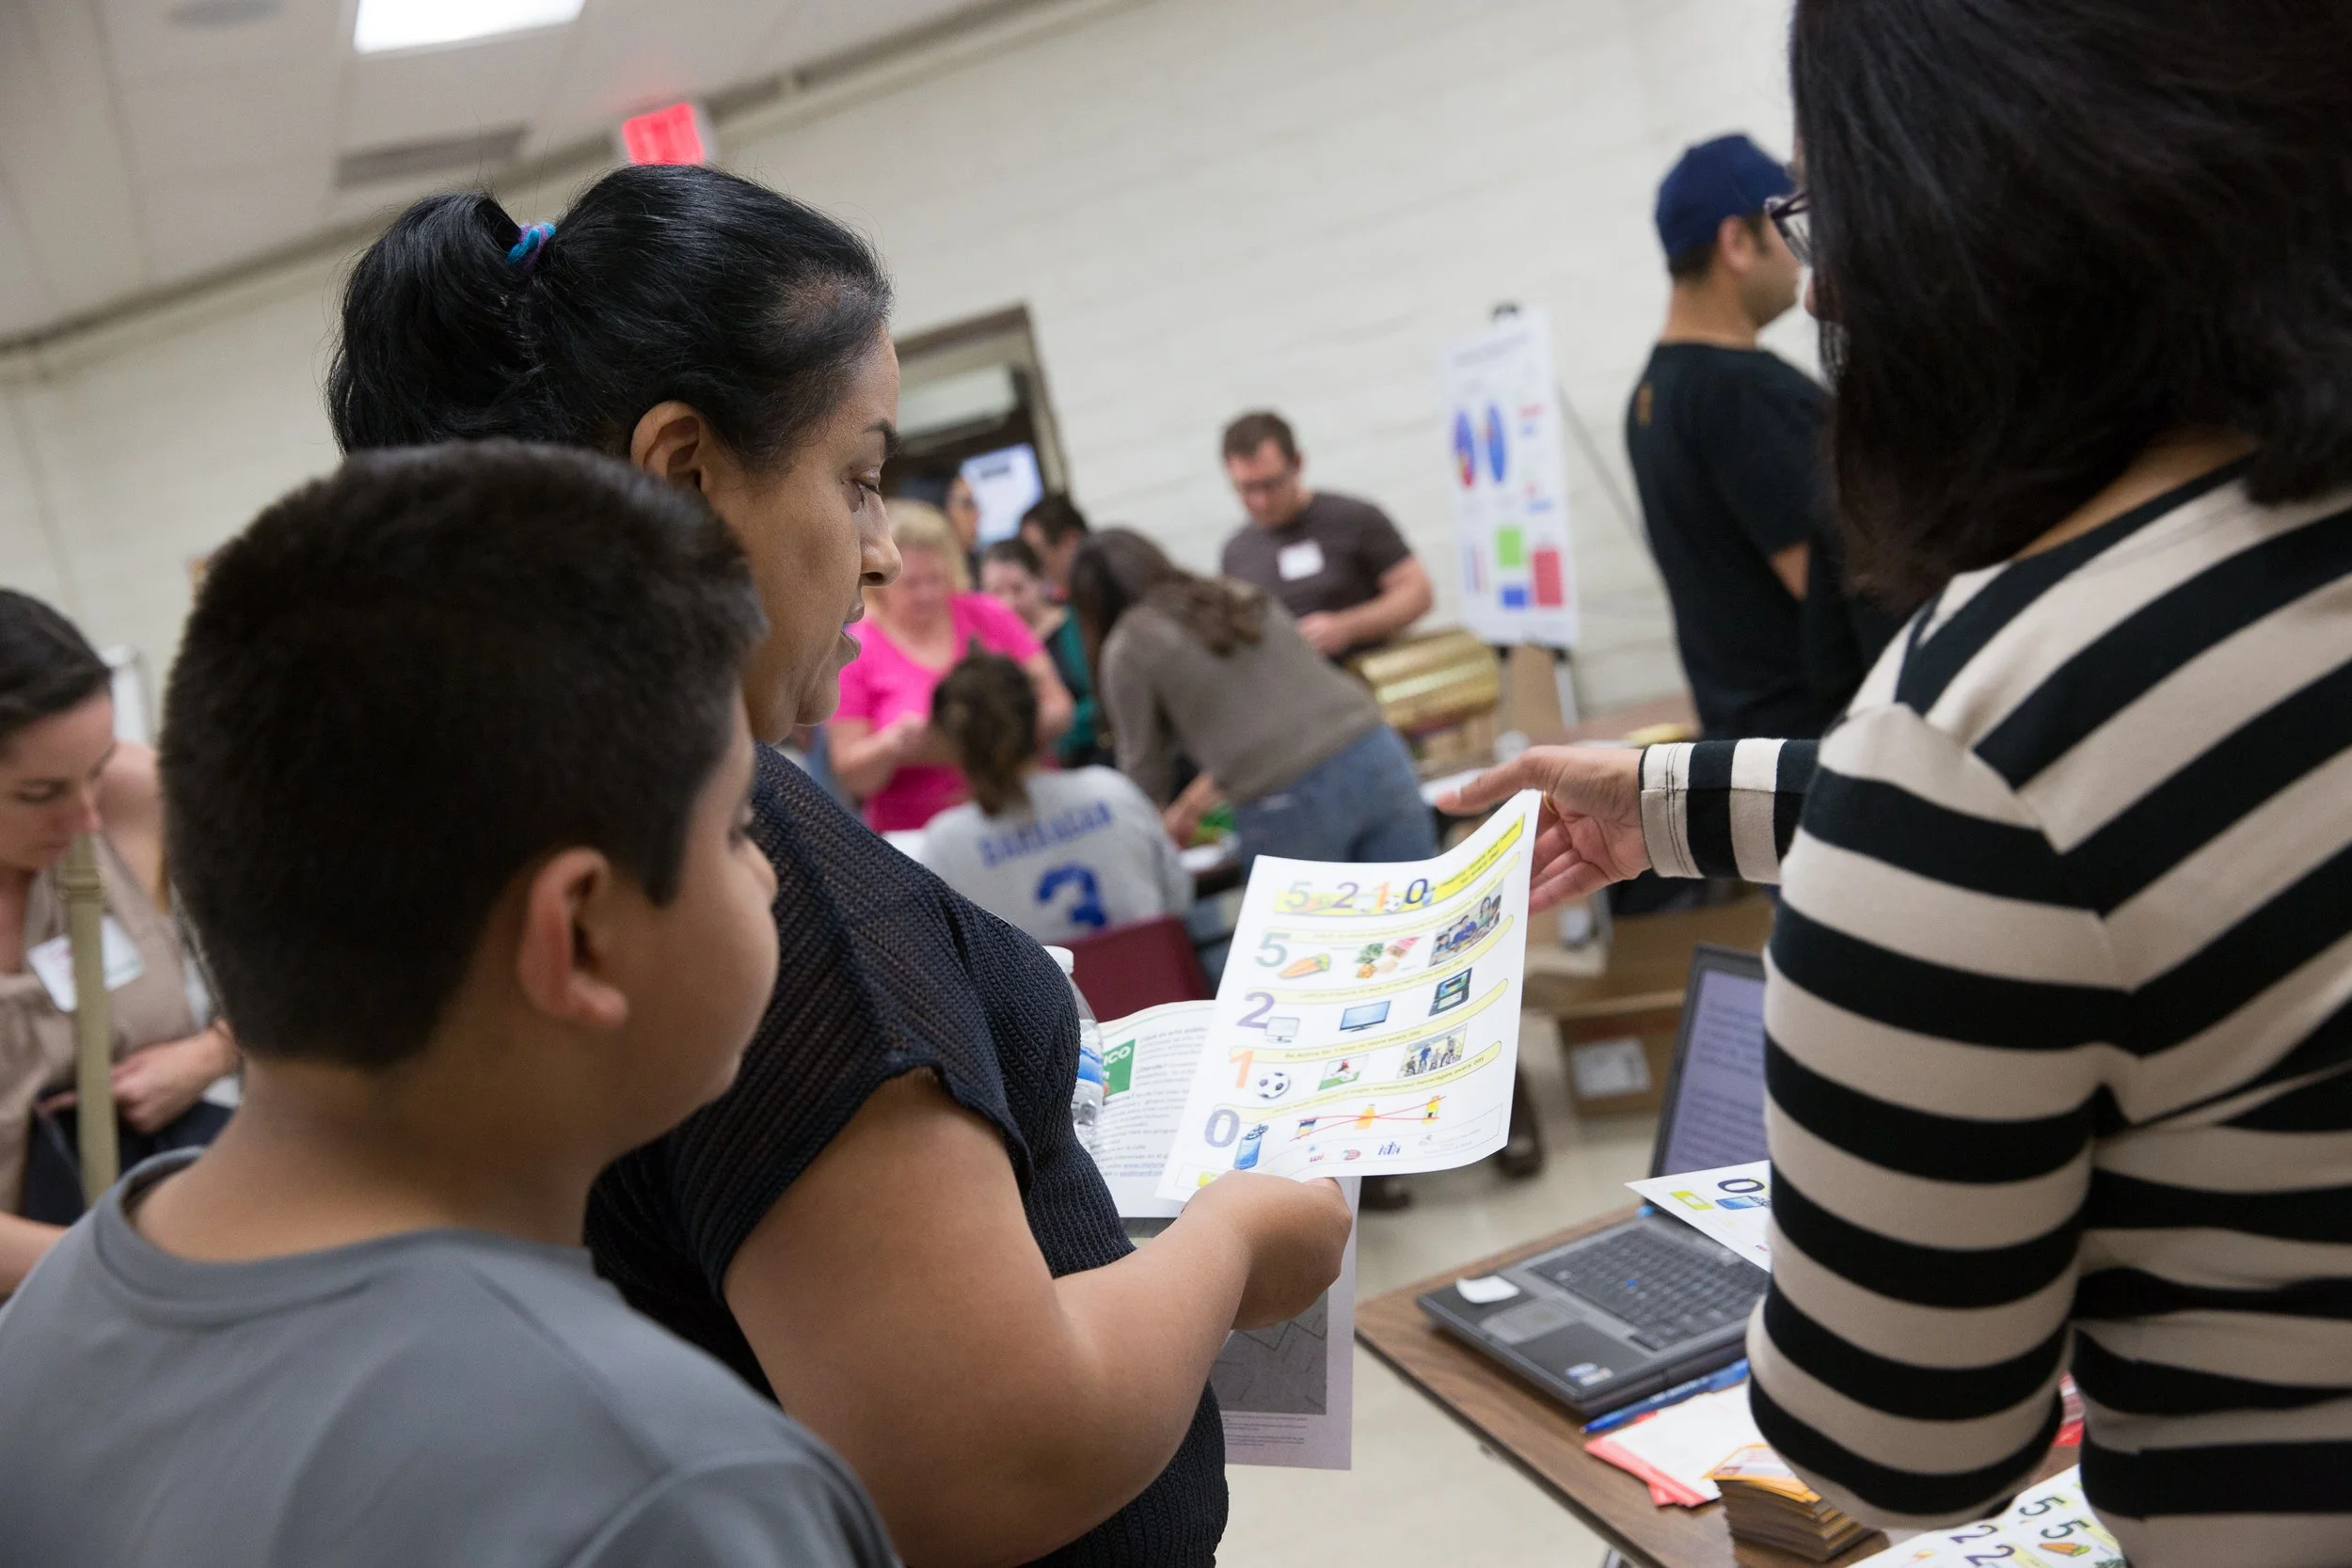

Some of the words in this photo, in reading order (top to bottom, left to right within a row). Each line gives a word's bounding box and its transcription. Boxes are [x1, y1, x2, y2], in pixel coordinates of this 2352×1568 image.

[1038, 863, 1107, 928] 3
[1285, 881, 1313, 908] 5
[1332, 882, 1359, 908] 2
[1374, 881, 1391, 909] 1
[1405, 879, 1429, 904] 0
[1255, 932, 1291, 968] 5
[1236, 992, 1277, 1029] 2
[1103, 1045, 1132, 1067] ICO
[1473, 1056, 1485, 1066] day
[1229, 1049, 1254, 1089] 1
[1203, 1108, 1240, 1148] 0
[1717, 1178, 1765, 1194] 0
[2019, 1497, 2066, 1516] 5
[1949, 1524, 1998, 1544] 2
[2041, 1519, 2091, 1539] 5
[1964, 1544, 2015, 1566] 2
